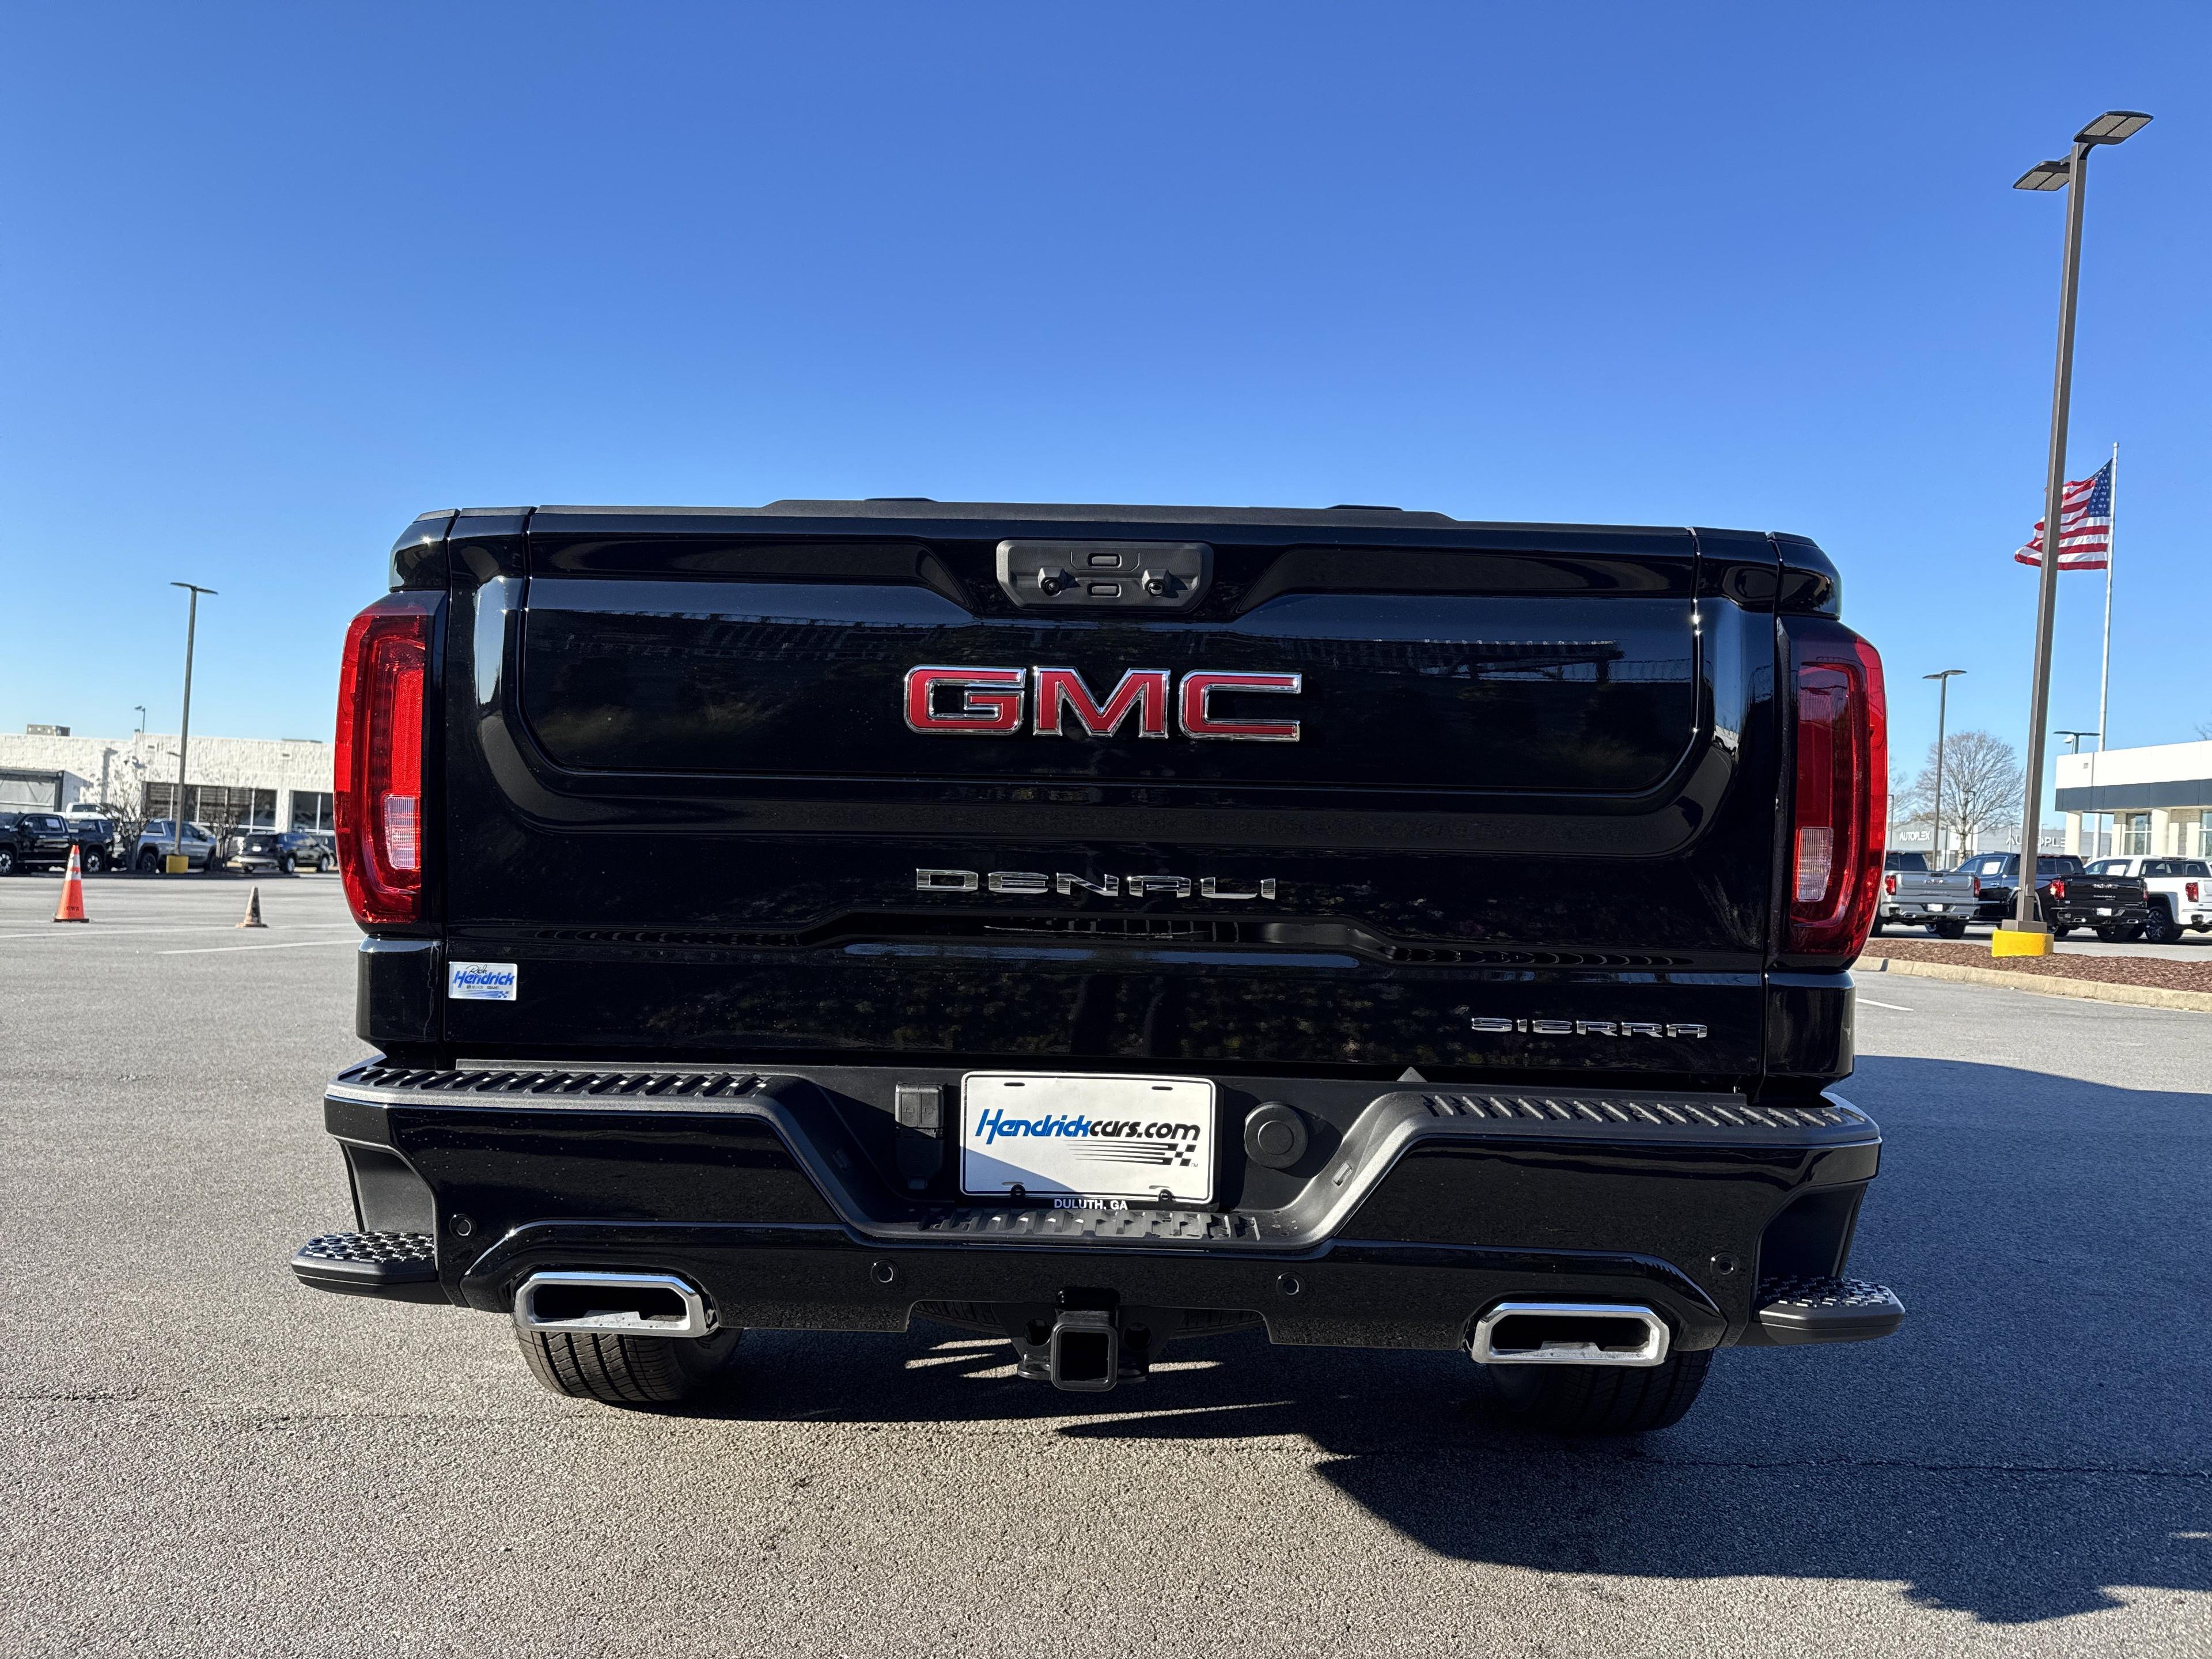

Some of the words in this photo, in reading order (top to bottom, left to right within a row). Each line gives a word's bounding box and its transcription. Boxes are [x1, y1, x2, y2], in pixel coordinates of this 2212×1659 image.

[903, 665, 1302, 743] GMC
[1899, 831, 1931, 841] AUTOPLEX
[2005, 835, 2066, 847] AUOPLE
[916, 868, 1276, 900] DENALI
[452, 971, 515, 988] Hendrick
[1471, 1017, 1707, 1038] SIERRA
[975, 1108, 1201, 1145] Hendrickcars.com
[1109, 1200, 1128, 1210] GA
